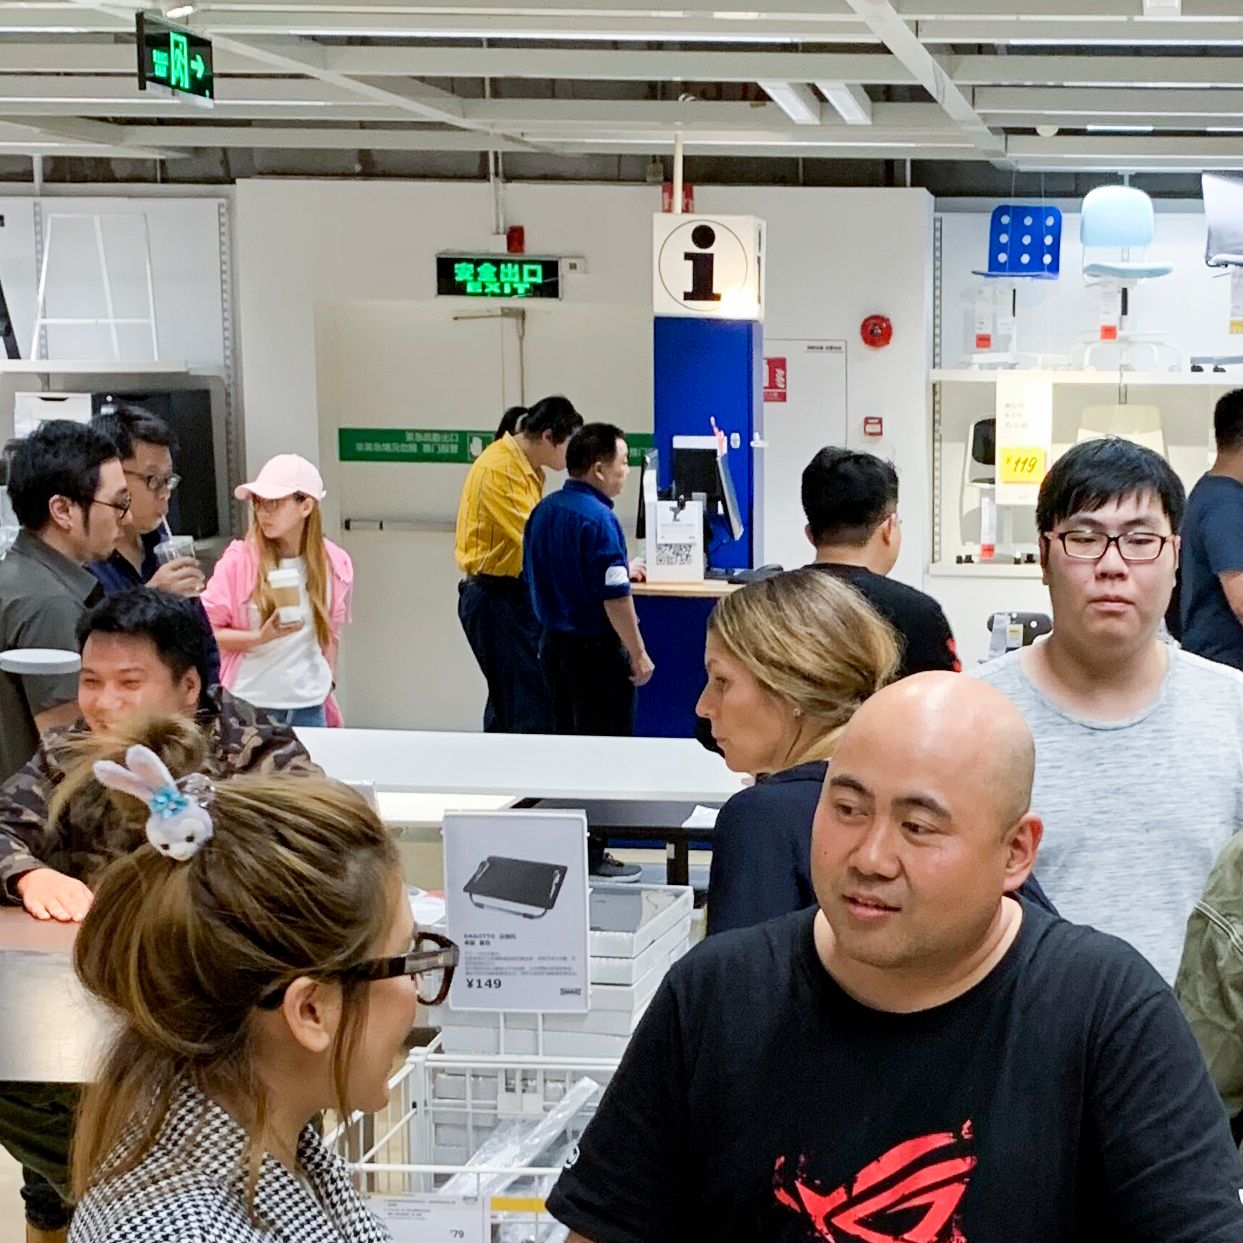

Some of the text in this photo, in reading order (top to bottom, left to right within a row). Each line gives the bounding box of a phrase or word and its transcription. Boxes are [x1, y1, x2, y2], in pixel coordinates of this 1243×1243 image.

[454, 262, 542, 284] 安全出口
[466, 978, 502, 989] ¥149
